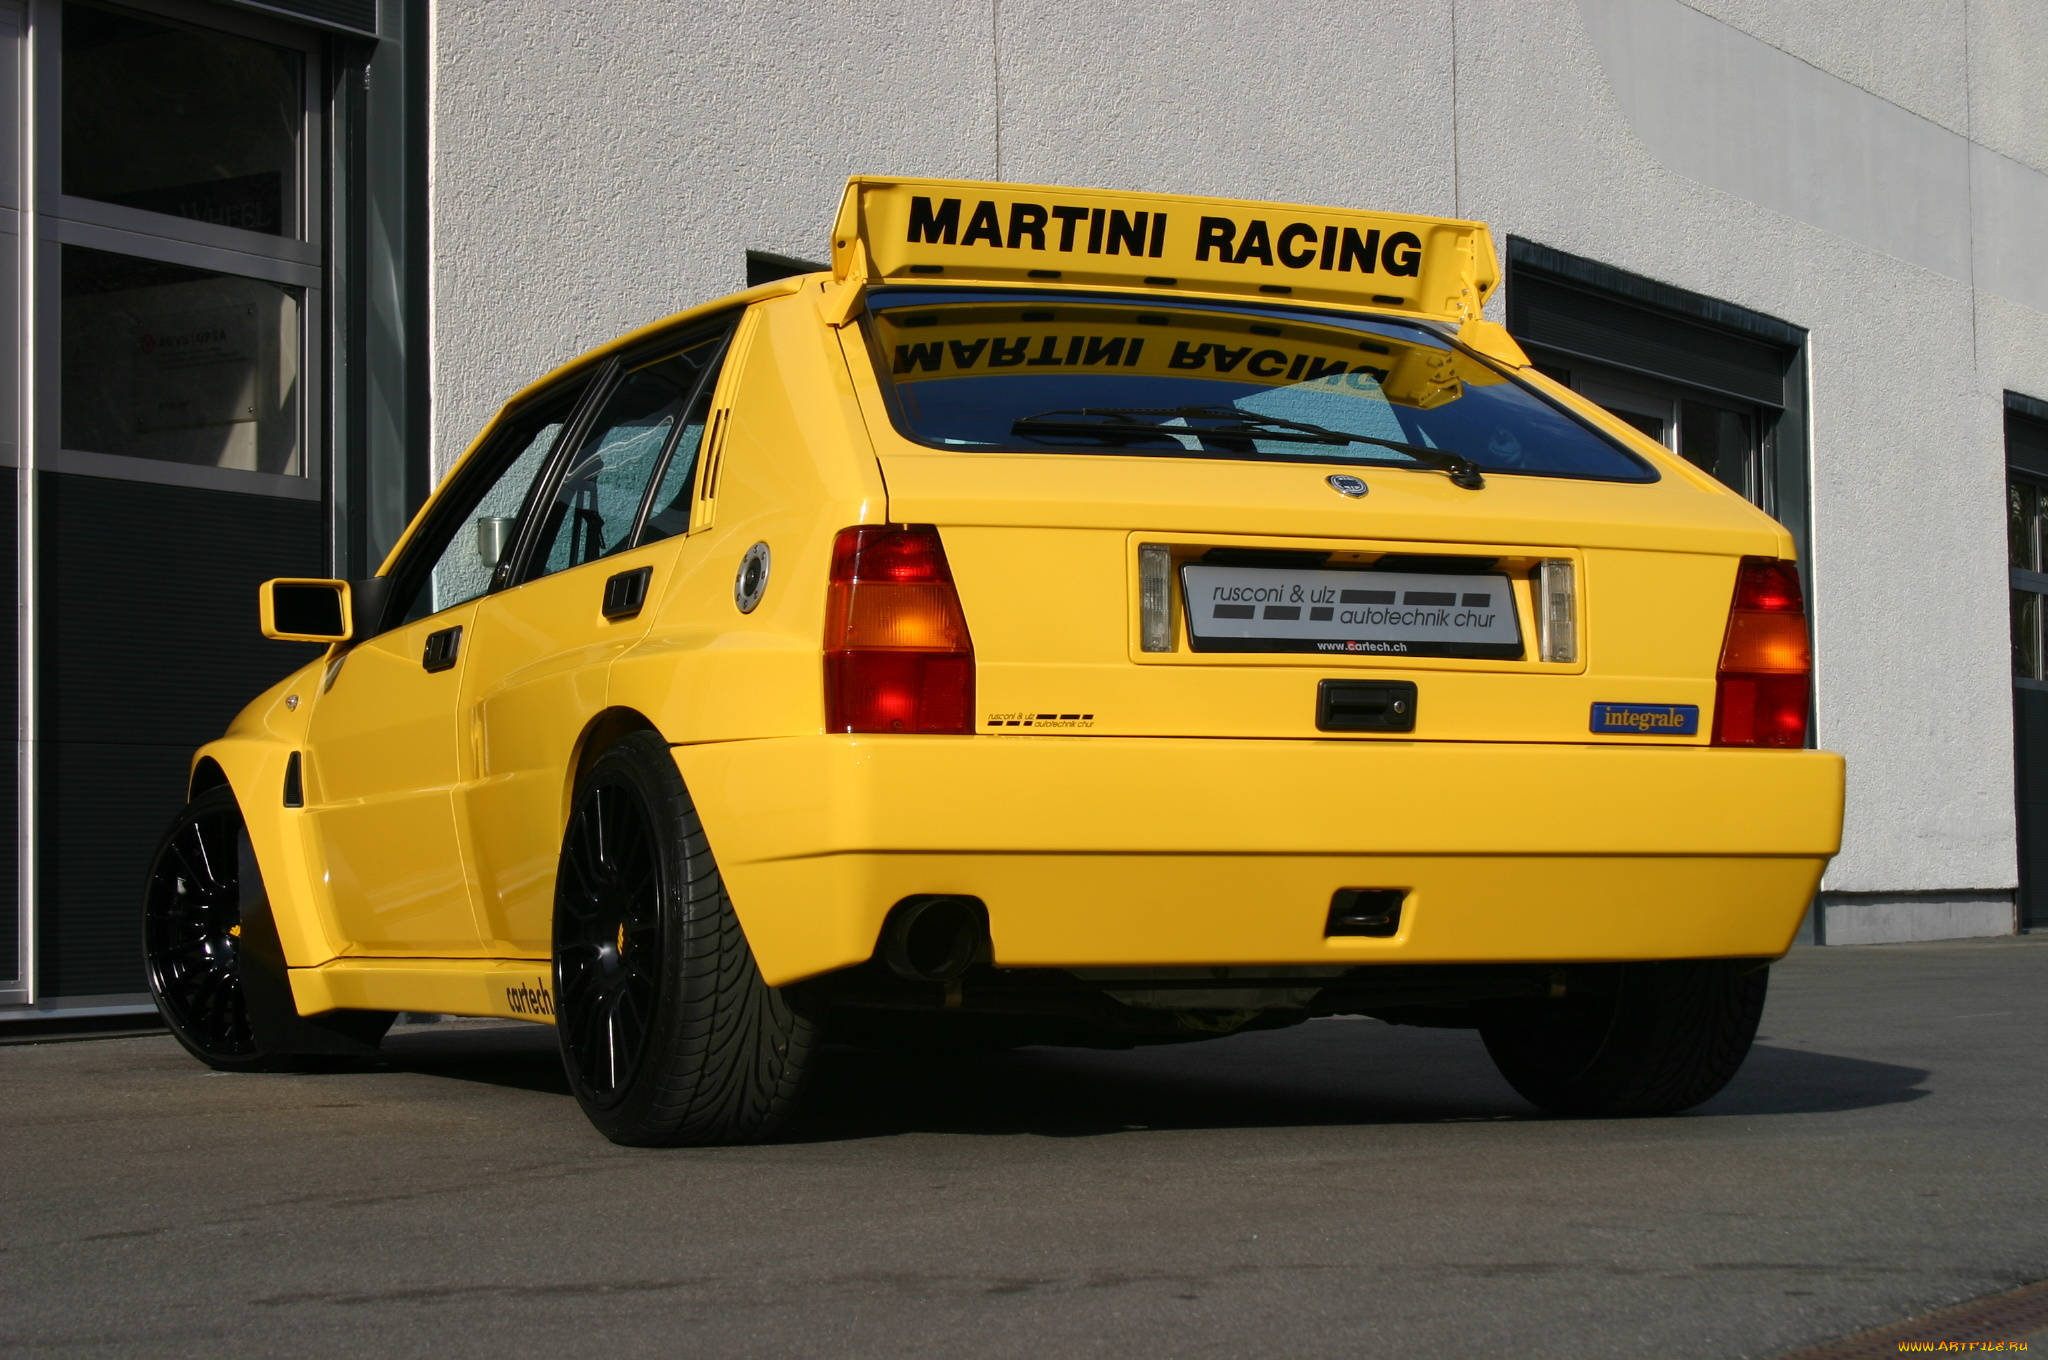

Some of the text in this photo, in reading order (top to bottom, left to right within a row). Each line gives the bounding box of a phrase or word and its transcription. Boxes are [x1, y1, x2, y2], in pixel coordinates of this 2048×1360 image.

[907, 196, 1422, 277] MARTINI RACING
[196, 330, 227, 343] UPSA
[1213, 584, 1336, 604] rusconi & ulz
[1340, 607, 1496, 627] autotechnik chur
[1317, 641, 1408, 652] www.cartech.ch
[988, 712, 1015, 720] rusconi
[1604, 706, 1684, 731] integrale
[506, 977, 555, 1015] cartech
